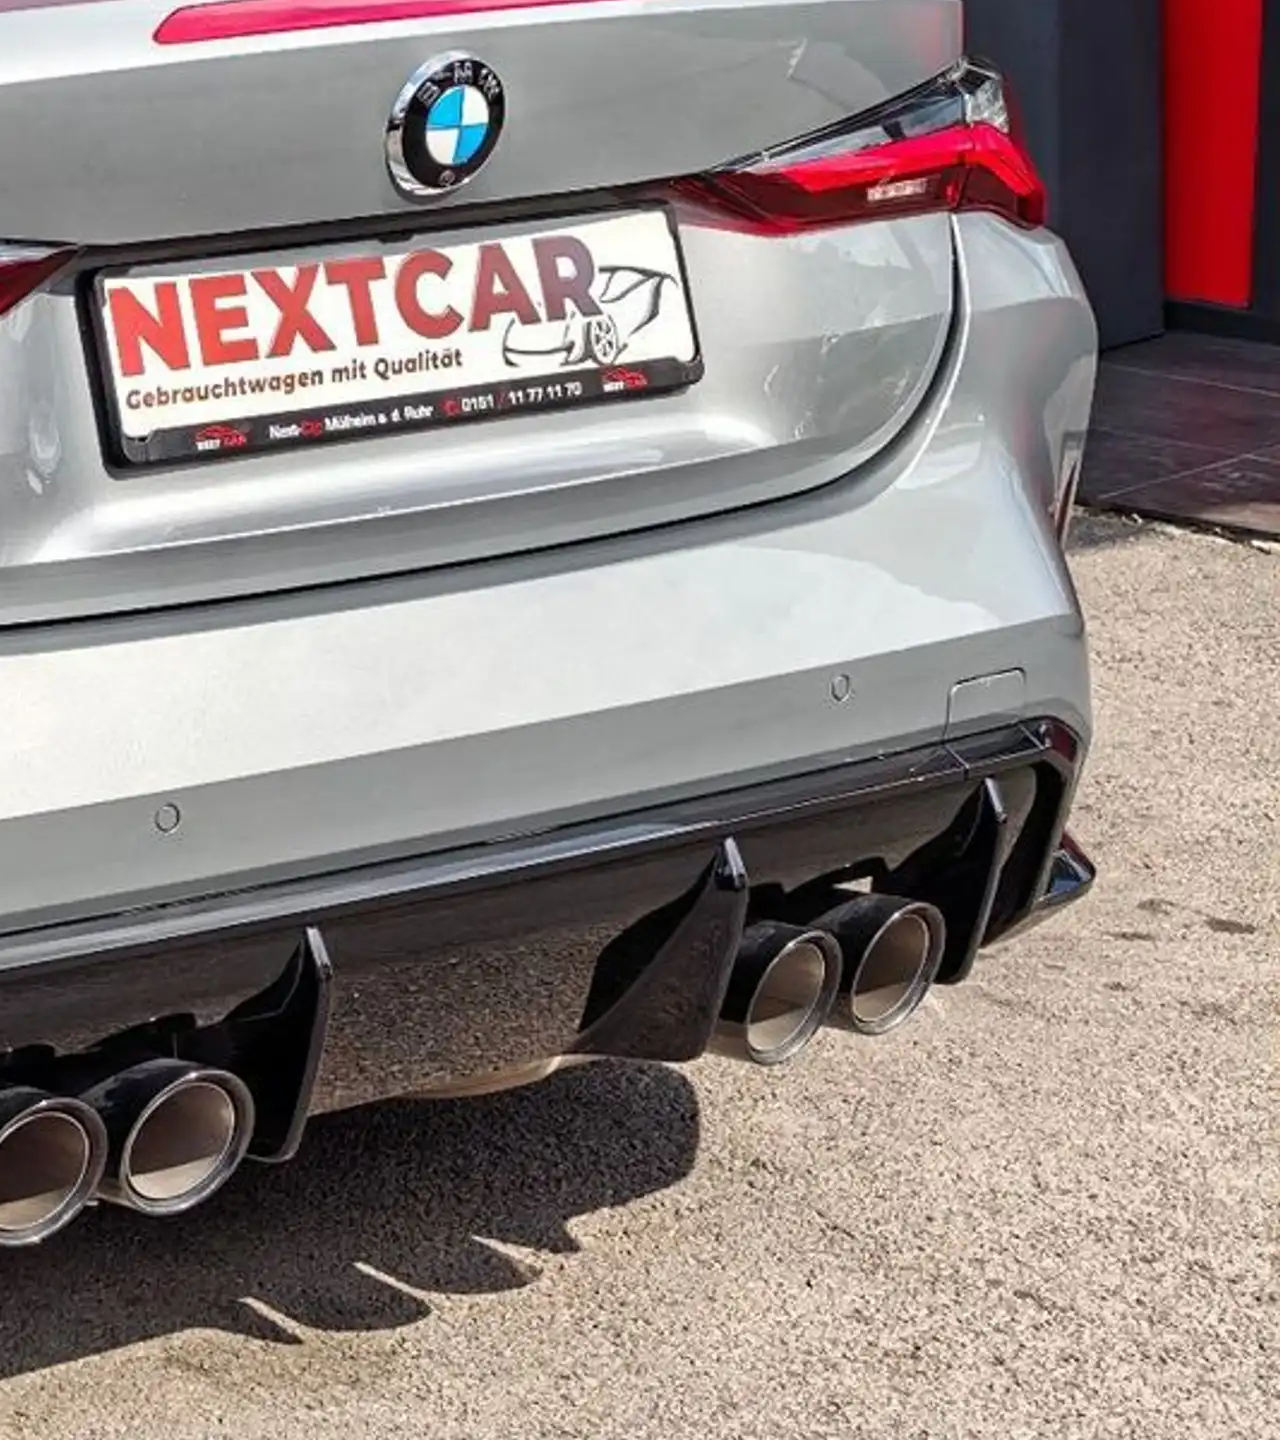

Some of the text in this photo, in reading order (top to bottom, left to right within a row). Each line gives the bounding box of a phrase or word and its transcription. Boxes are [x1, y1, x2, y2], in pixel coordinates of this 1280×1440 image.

[107, 234, 606, 378] NEXTCAR
[125, 347, 464, 410] Gebrauchtwagen mit Qualität
